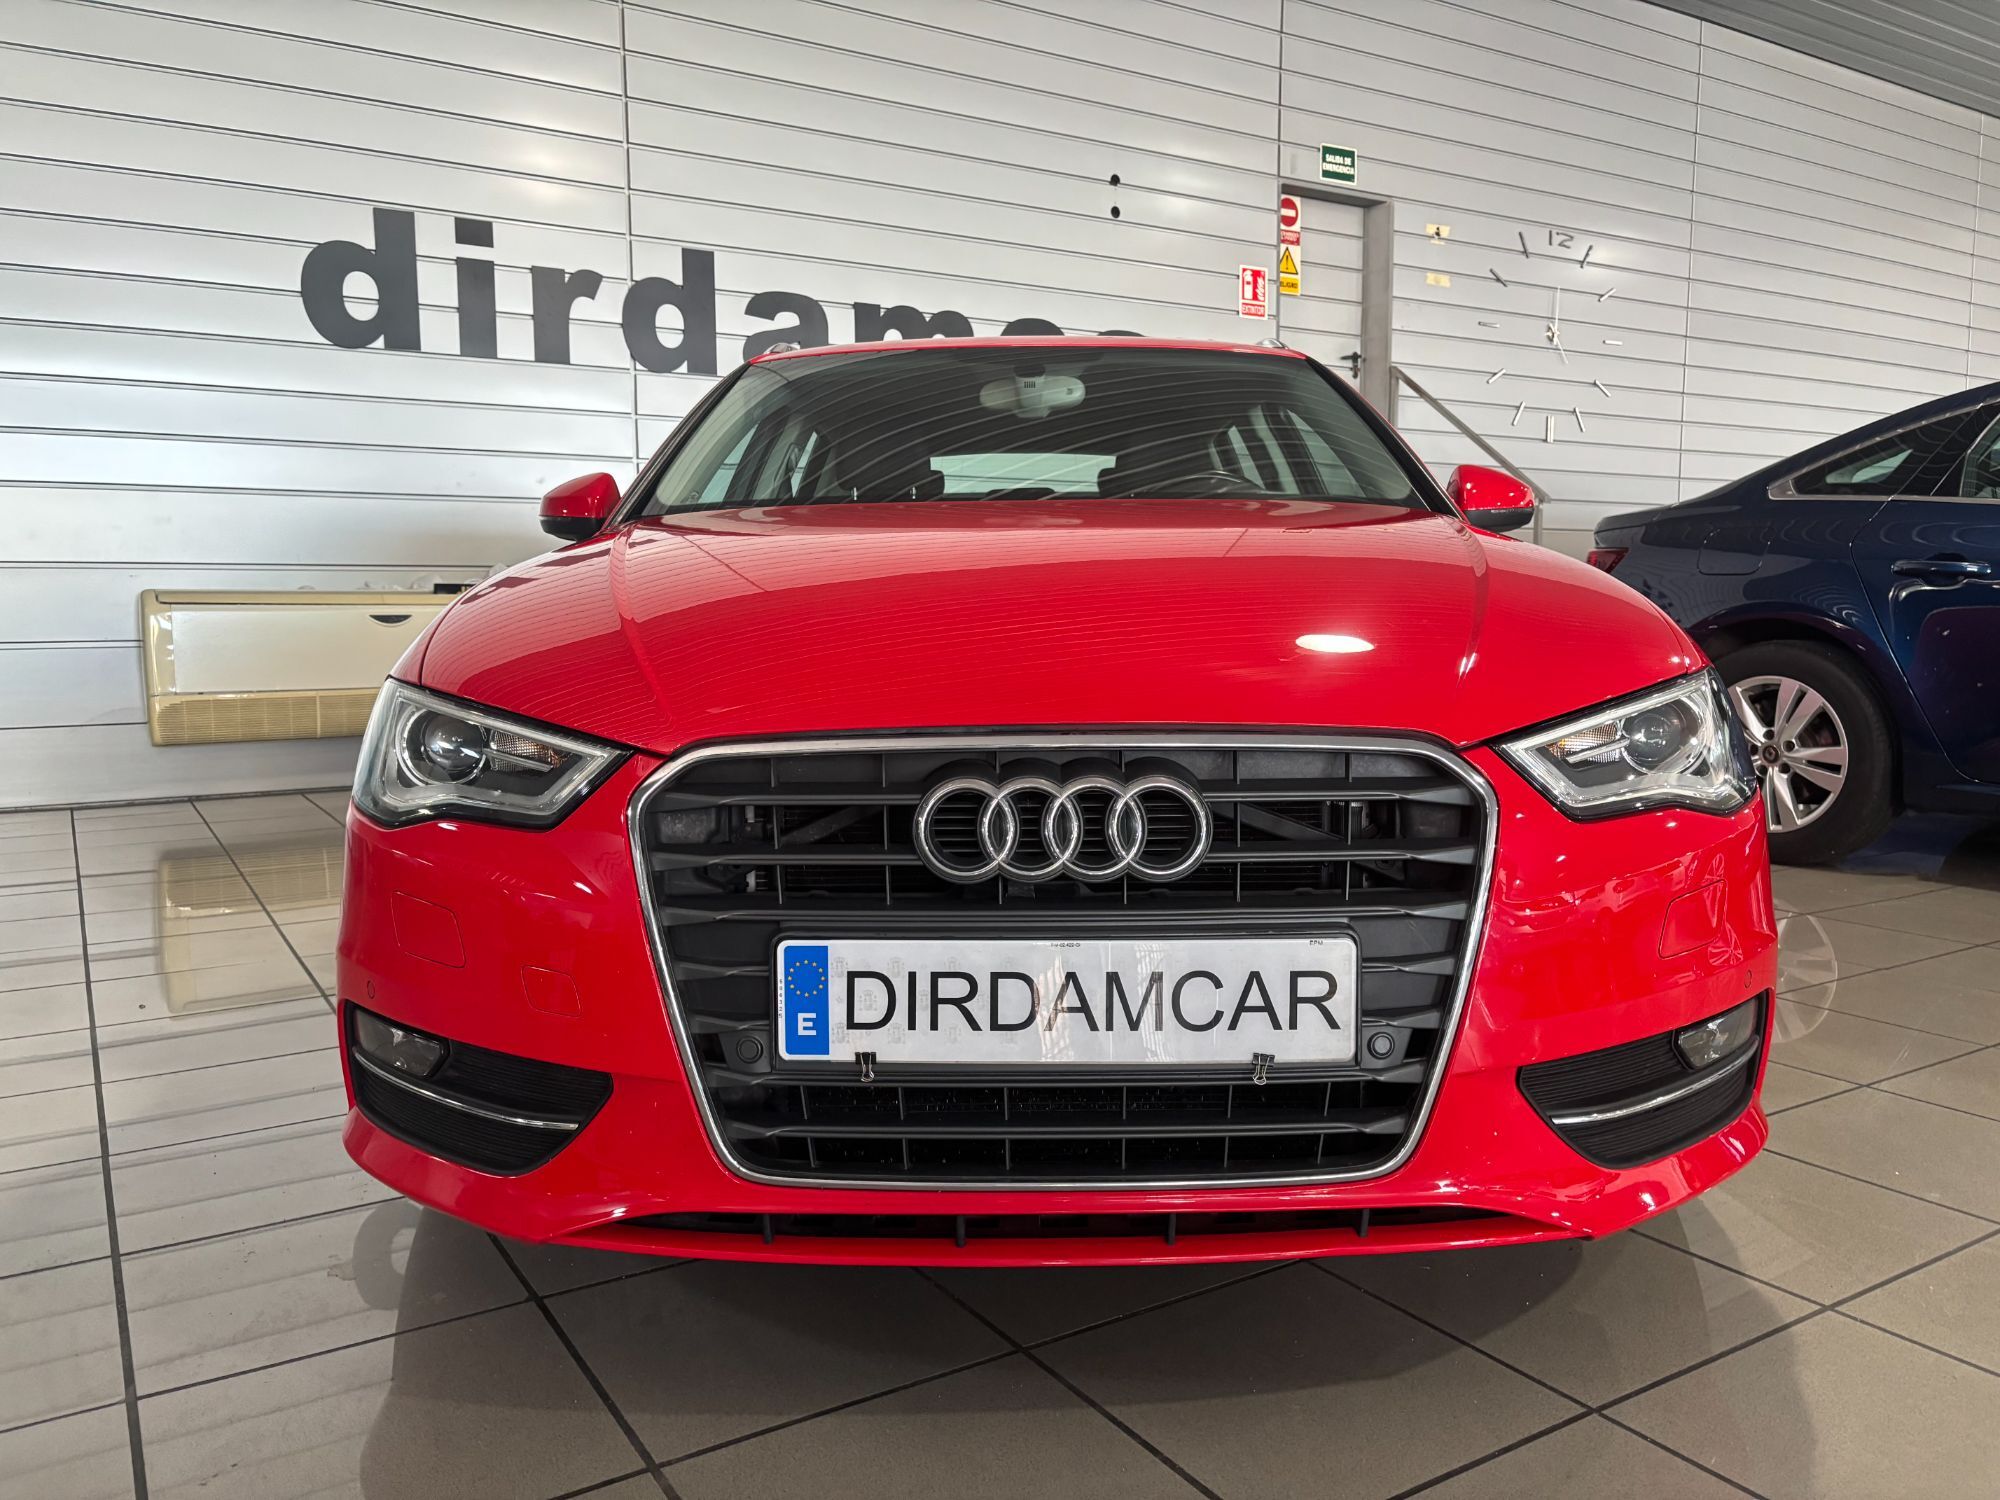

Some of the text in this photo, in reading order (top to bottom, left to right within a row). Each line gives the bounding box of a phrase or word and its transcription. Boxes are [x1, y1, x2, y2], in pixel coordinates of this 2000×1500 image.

[1322, 162, 1355, 175] EMERGENCIA
[1325, 153, 1352, 166] SALIDA DE
[1548, 229, 1575, 249] 12
[301, 207, 1149, 376] dirda
[844, 969, 1341, 1033] DIRDAMCAR
[797, 1012, 817, 1036] E
